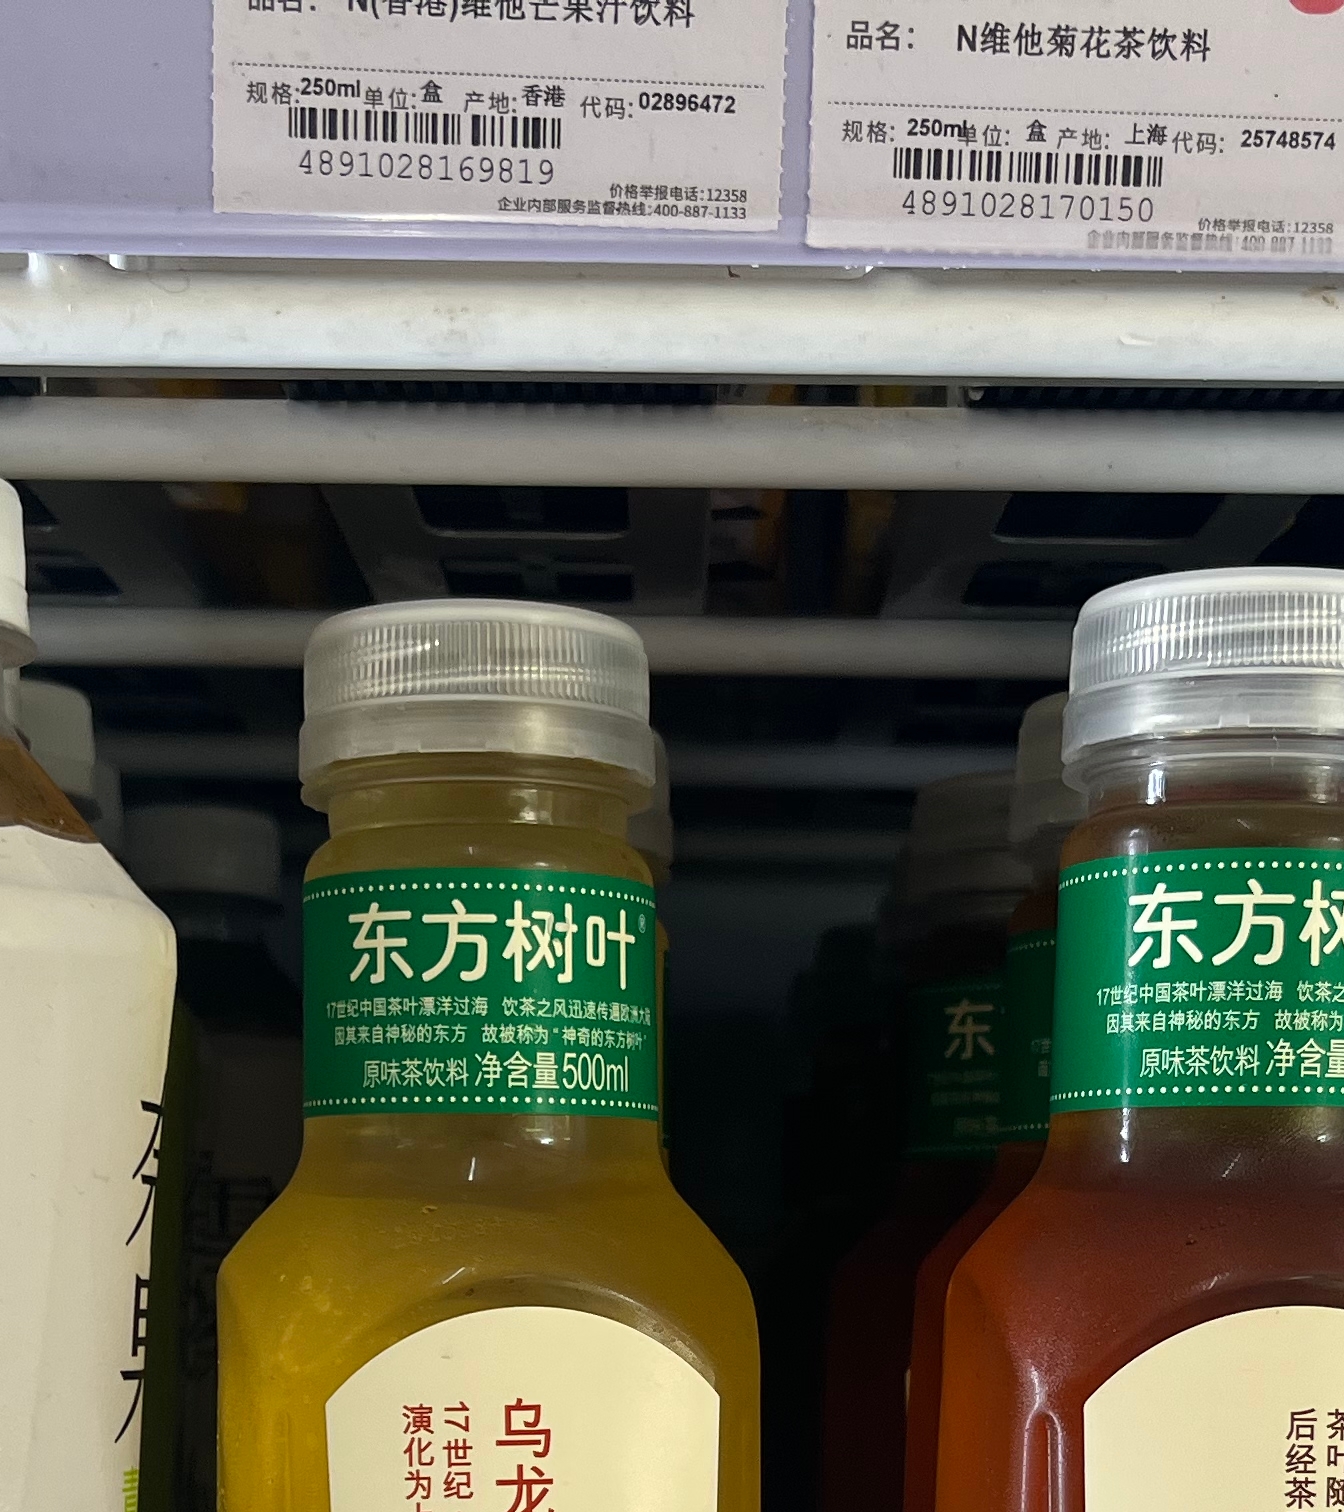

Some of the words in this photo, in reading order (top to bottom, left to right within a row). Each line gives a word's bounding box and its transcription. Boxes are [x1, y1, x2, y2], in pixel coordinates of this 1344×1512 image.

[957, 24, 1210, 63] N维他菊花茶饮料
[300, 77, 362, 98] 250ml
[421, 80, 443, 103] 盒
[523, 84, 565, 107] 香港
[639, 92, 736, 114] 02896472
[1026, 120, 1047, 143] 盒
[1125, 123, 1169, 146] 上海
[1240, 129, 1336, 151] 25748574
[299, 150, 555, 185] 4891028169819
[902, 191, 1155, 223] 4891028170150
[348, 899, 636, 990] 东方树叶
[327, 996, 488, 1018] 17世纪中国茶叶漂洋过海
[1096, 980, 1283, 1006] 17世纪中国茶叶漂洋过海
[334, 1023, 467, 1046] 因其来自神秘的东方
[1106, 1009, 1260, 1034] 因其来自神秘的东方
[363, 1057, 469, 1089] 原味茶饮料
[474, 1051, 629, 1092] 净含量500ml
[1140, 1044, 1260, 1078] 原味茶饮料
